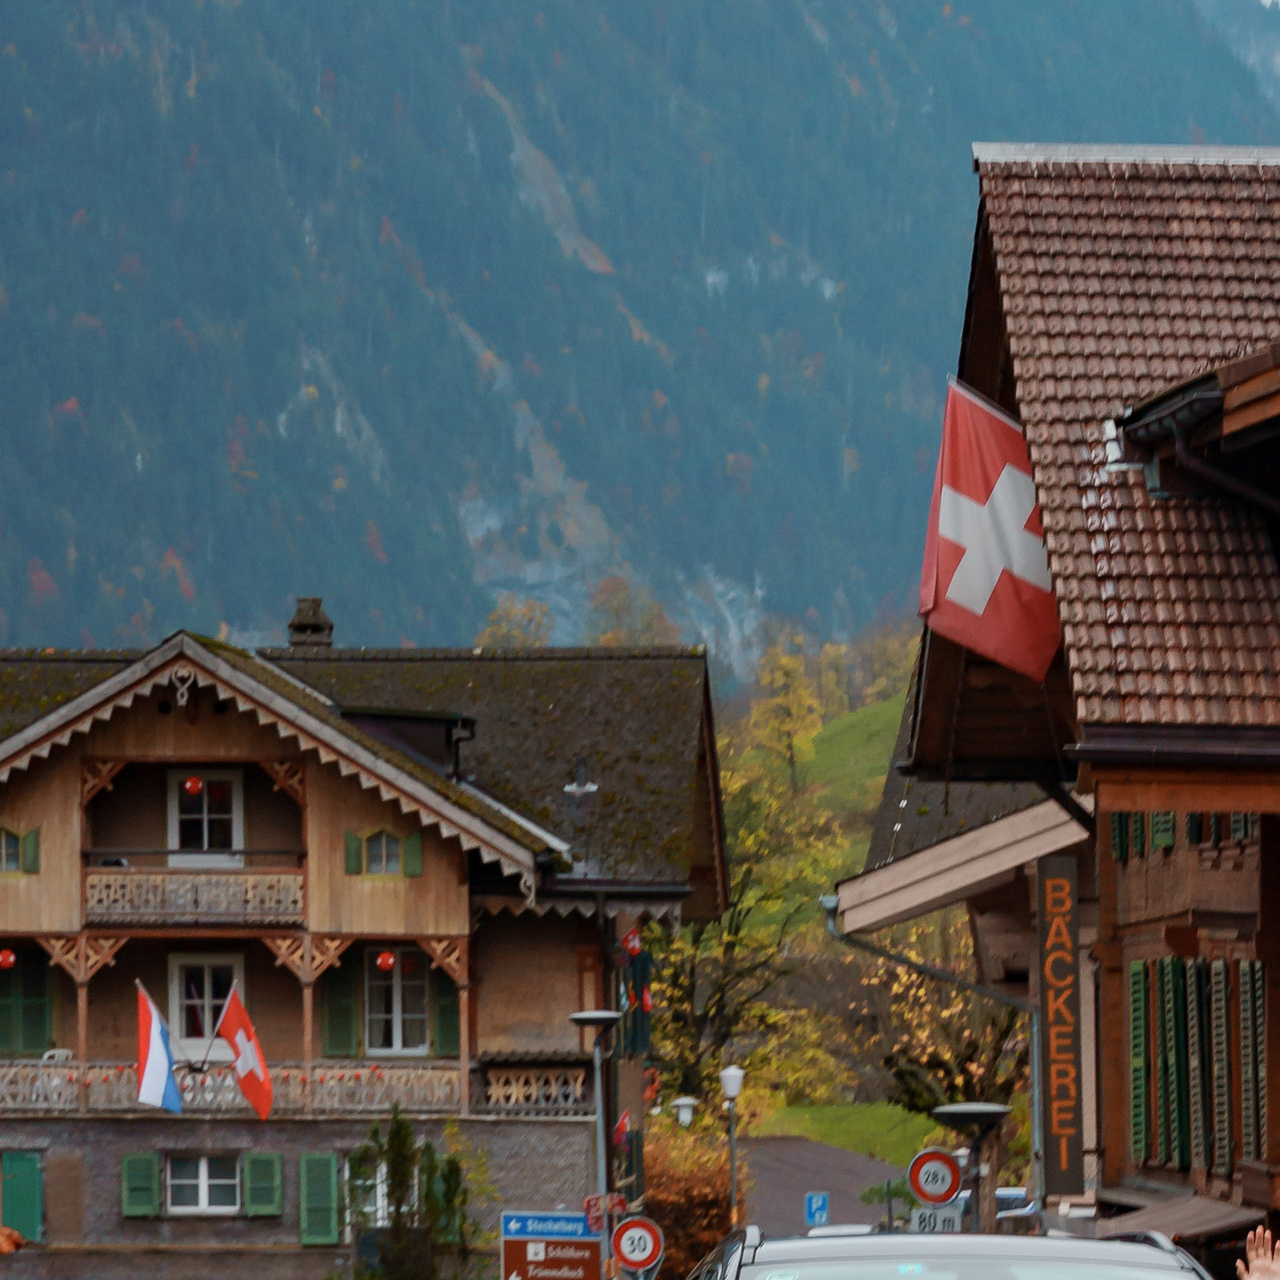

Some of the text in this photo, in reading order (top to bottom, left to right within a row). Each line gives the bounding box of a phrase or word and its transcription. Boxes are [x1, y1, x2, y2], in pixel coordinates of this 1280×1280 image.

[1043, 877, 1078, 1172] BÄCKEREI
[918, 1212, 956, 1232] 80 m
[627, 1234, 648, 1254] 30
